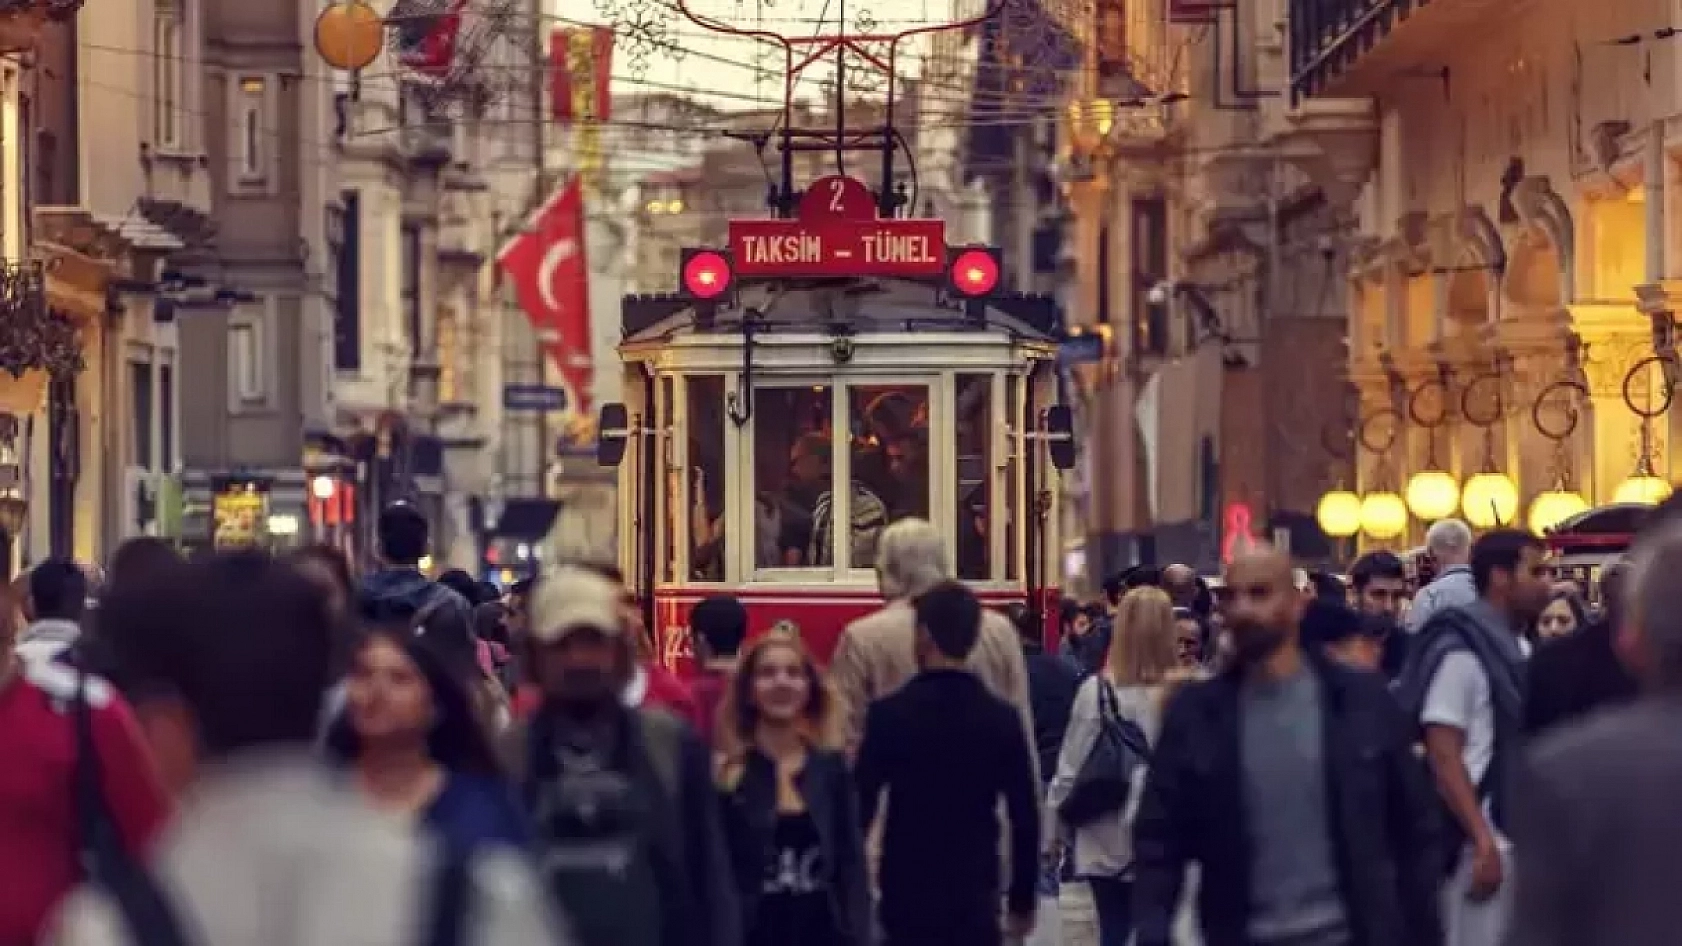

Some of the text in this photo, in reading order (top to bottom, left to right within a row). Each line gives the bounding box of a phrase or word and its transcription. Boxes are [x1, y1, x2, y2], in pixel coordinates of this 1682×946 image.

[829, 179, 845, 212] 2
[742, 231, 821, 263] TAKSİM
[861, 231, 936, 263] TÜNEL
